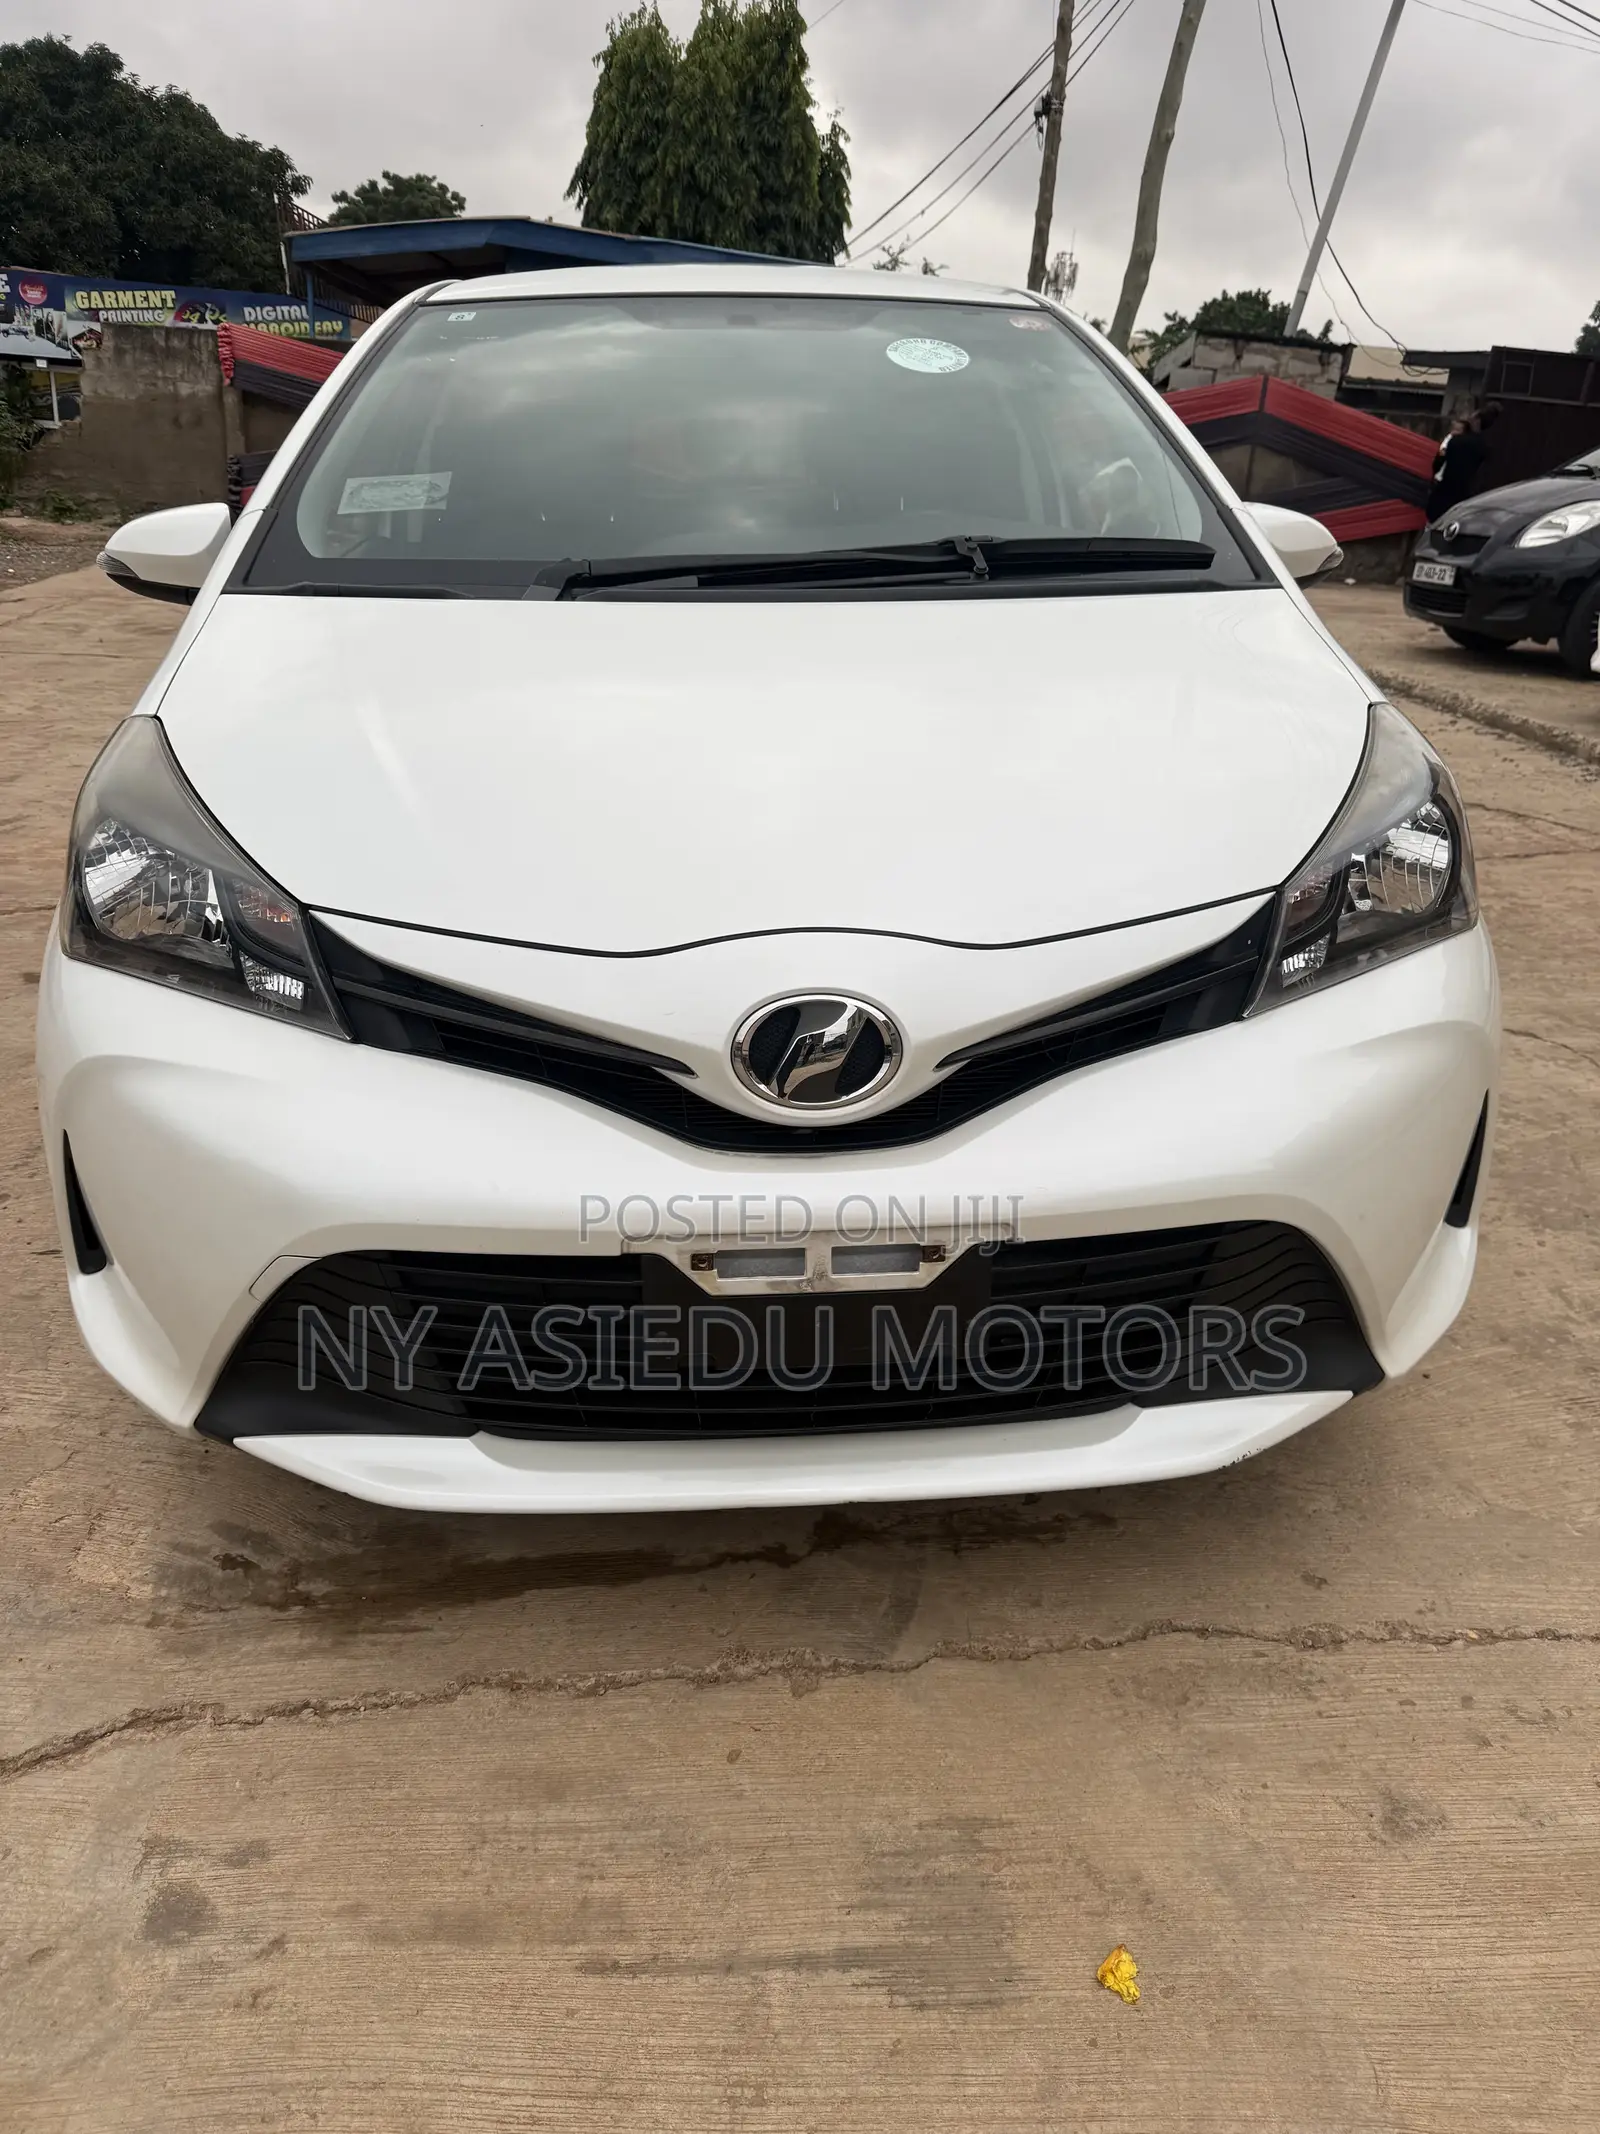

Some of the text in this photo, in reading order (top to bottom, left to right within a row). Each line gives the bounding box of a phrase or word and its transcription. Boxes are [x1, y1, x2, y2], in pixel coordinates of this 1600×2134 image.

[75, 289, 176, 310] GARMENT
[98, 309, 165, 323] PRINTING
[243, 304, 310, 321] DIGITAL
